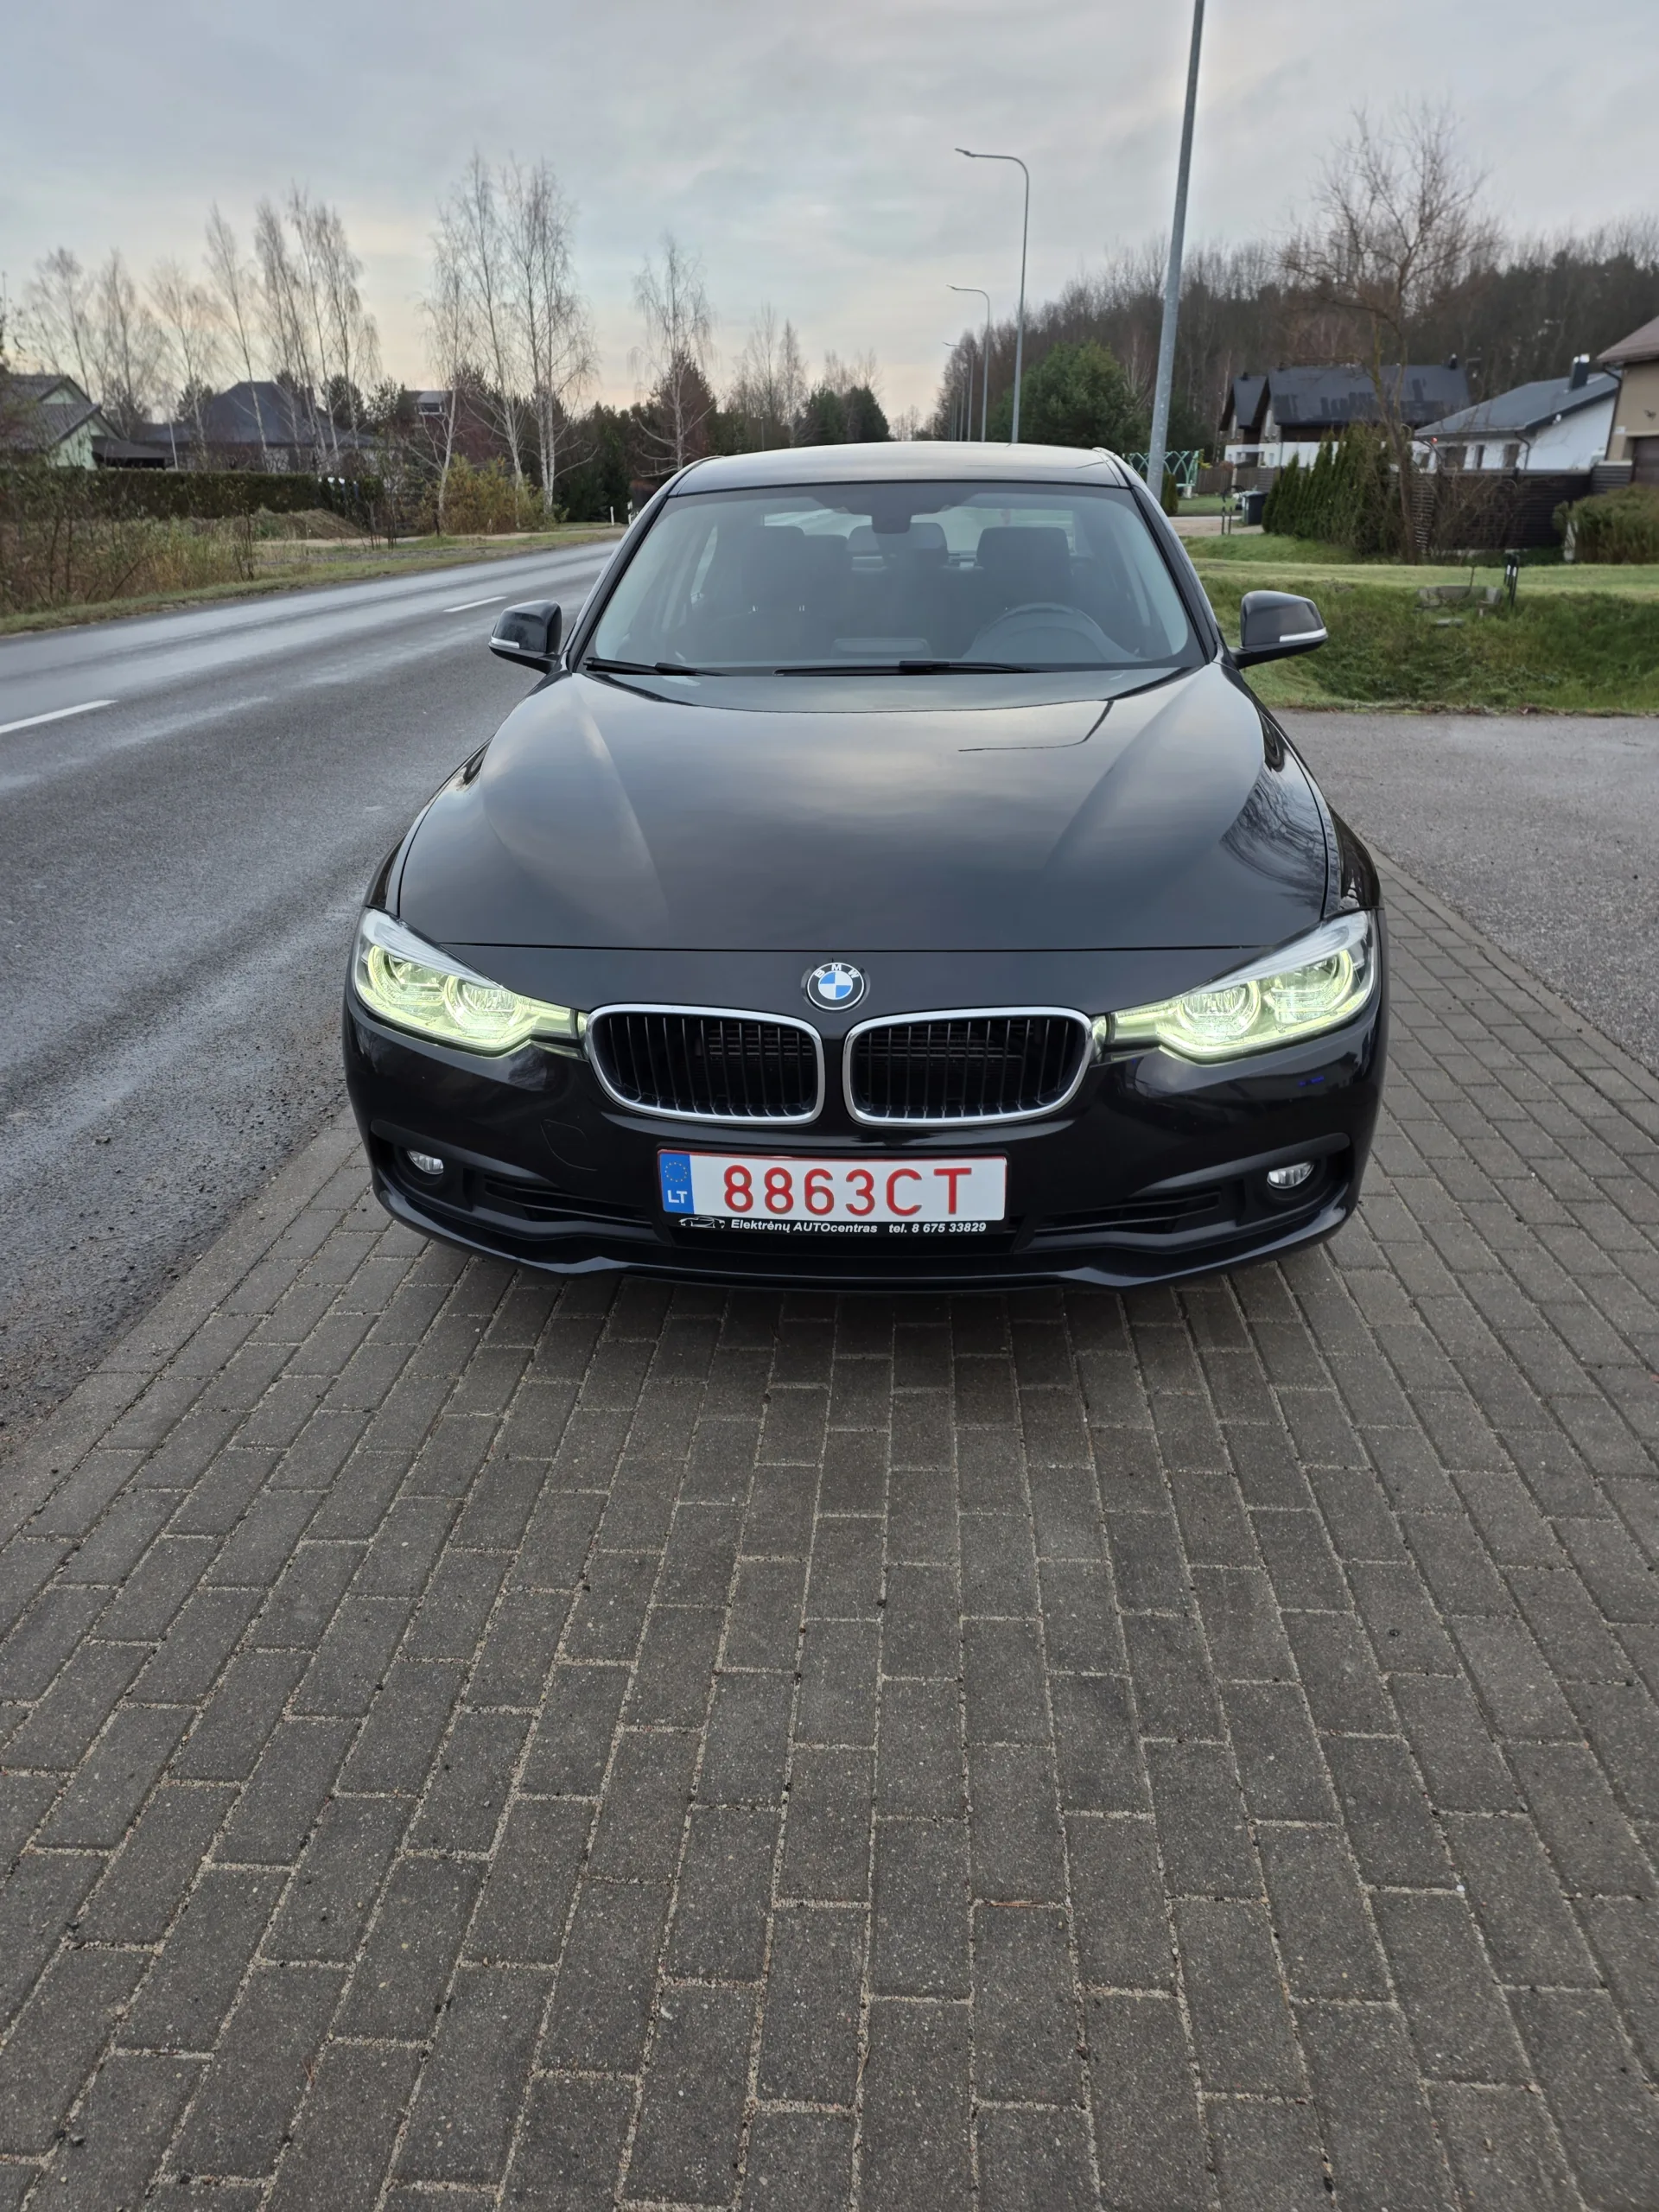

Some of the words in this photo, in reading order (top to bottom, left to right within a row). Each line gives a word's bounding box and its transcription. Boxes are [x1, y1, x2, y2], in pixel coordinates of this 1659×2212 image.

[813, 963, 860, 979] BMW
[667, 1190, 689, 1205] LT
[723, 1164, 973, 1216] 8863CT
[731, 1219, 791, 1234] Elektrėnų
[793, 1222, 878, 1234] AUTOcentras
[888, 1224, 907, 1234] tel.
[912, 1224, 920, 1233] 8
[923, 1223, 946, 1233] 675
[949, 1222, 987, 1233] 33829
